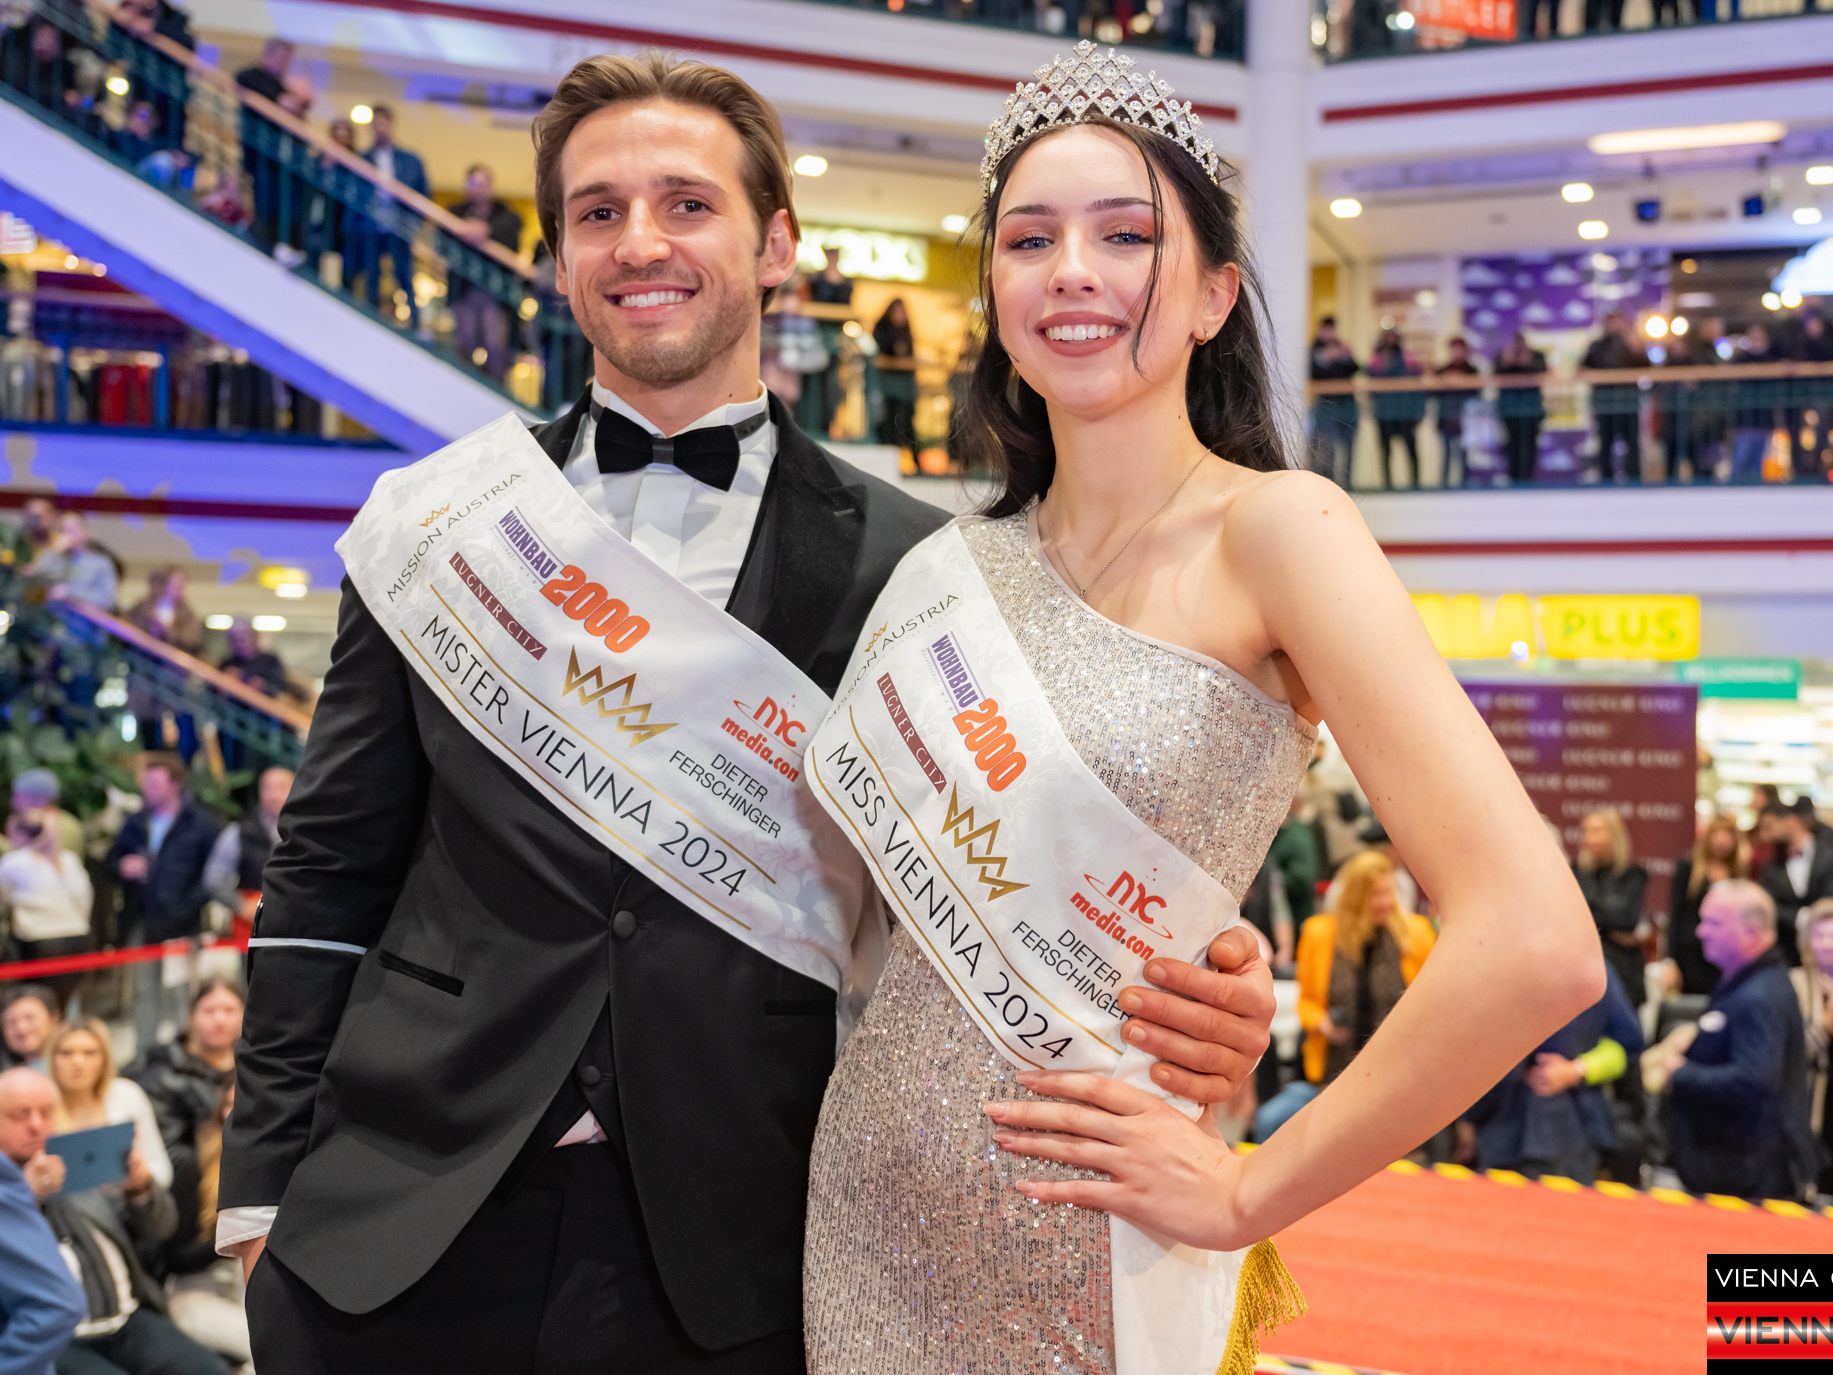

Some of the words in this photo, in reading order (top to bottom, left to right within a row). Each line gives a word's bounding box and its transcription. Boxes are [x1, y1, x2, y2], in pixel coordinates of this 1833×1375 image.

[387, 527, 443, 602] MISSION
[447, 473, 523, 529] AUSTRIA
[499, 510, 558, 579] WOHNBAU
[539, 564, 651, 654] 2000
[507, 620, 544, 653] CITY
[882, 594, 959, 650] AUSTRIA
[1563, 608, 1683, 646] PLUS
[931, 634, 979, 708] WOHNBAU
[421, 615, 509, 725] MISTER
[521, 709, 652, 834] VIENNA
[658, 821, 747, 897] 2024
[710, 754, 768, 802] DIETER
[720, 718, 800, 783] media.con
[916, 747, 945, 785] CITY
[952, 698, 1027, 792] 2000
[669, 750, 781, 838] FERSCHINGER
[826, 741, 885, 827] MISS
[884, 821, 982, 978] VIENNA
[983, 971, 1073, 1059] 2024
[1070, 891, 1155, 961] media.con
[1057, 929, 1121, 987] DIETER
